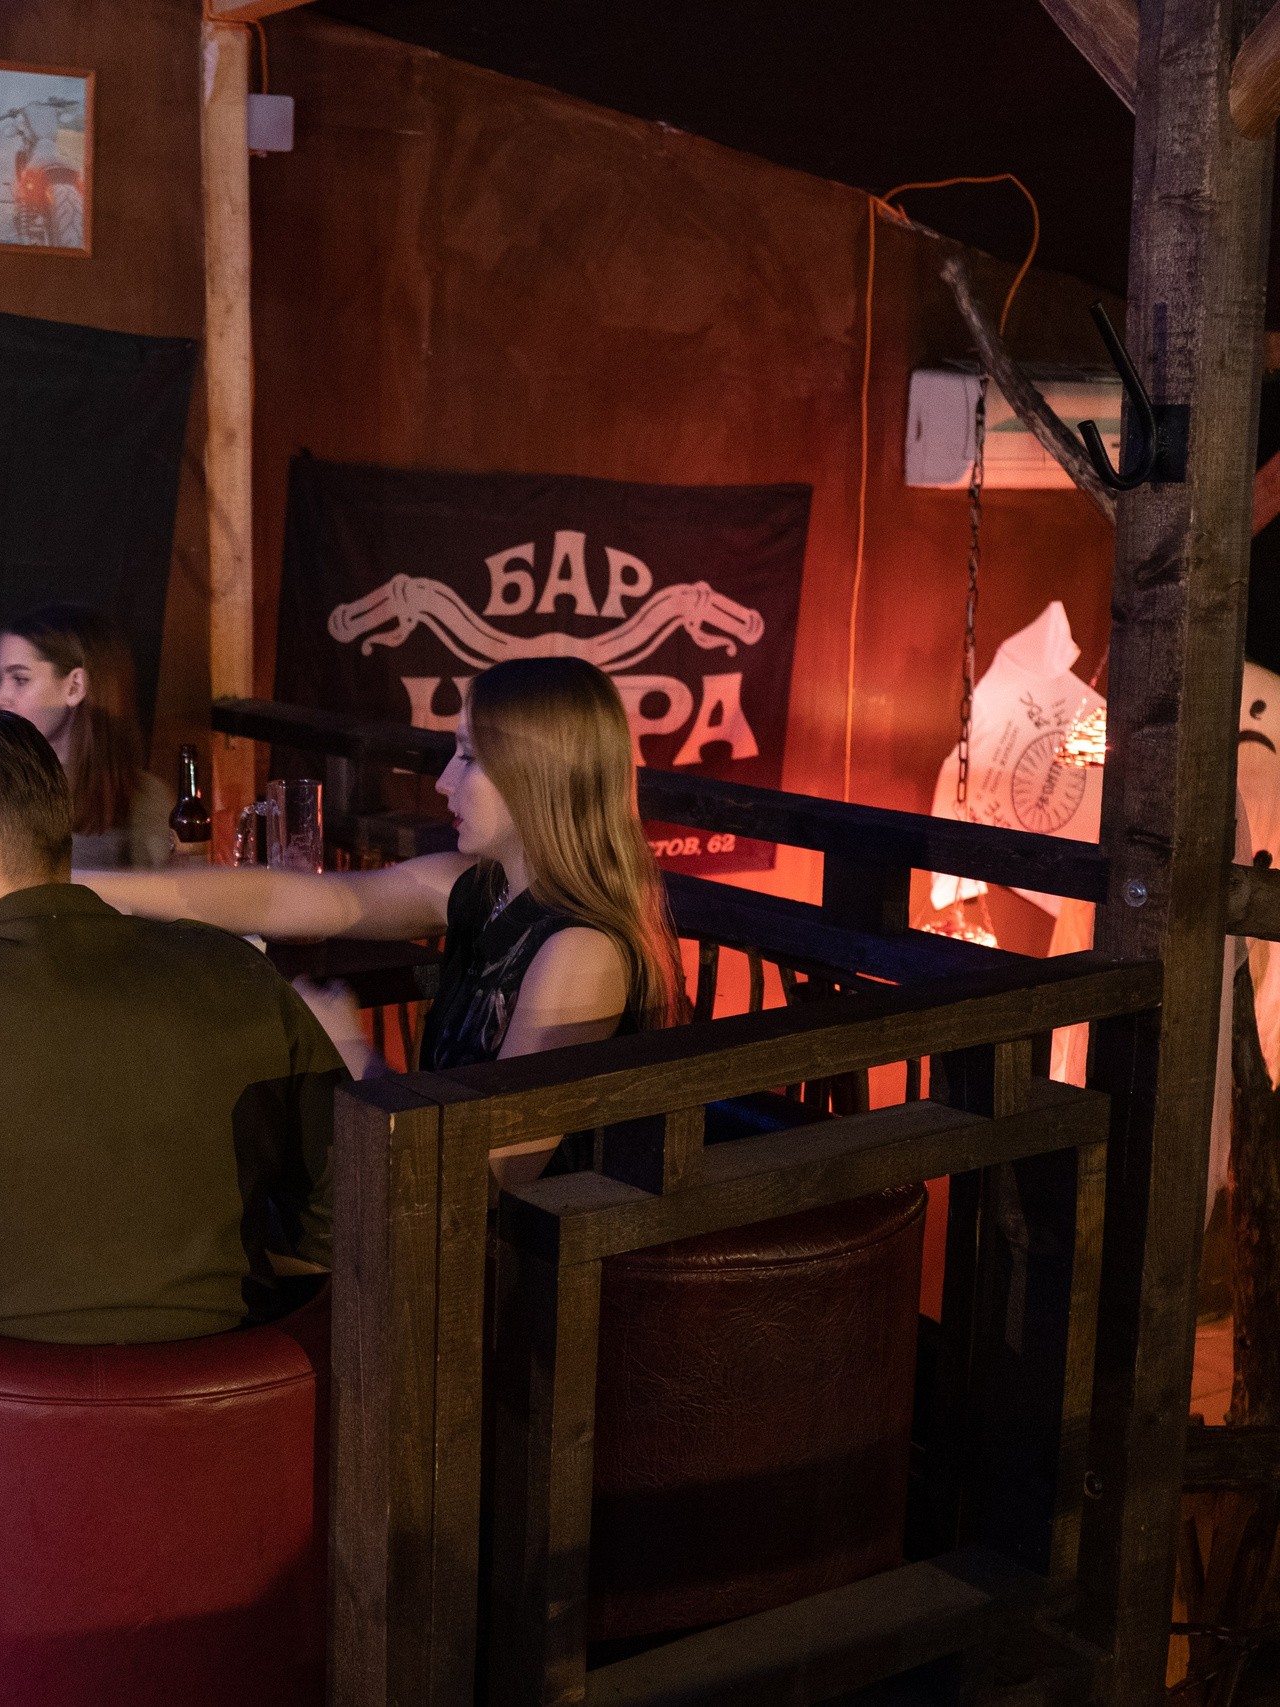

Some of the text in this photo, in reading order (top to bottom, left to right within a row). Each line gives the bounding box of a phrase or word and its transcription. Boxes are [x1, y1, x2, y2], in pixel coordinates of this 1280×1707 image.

[483, 530, 652, 617] БАР
[647, 833, 736, 858] ТОВ, 62
